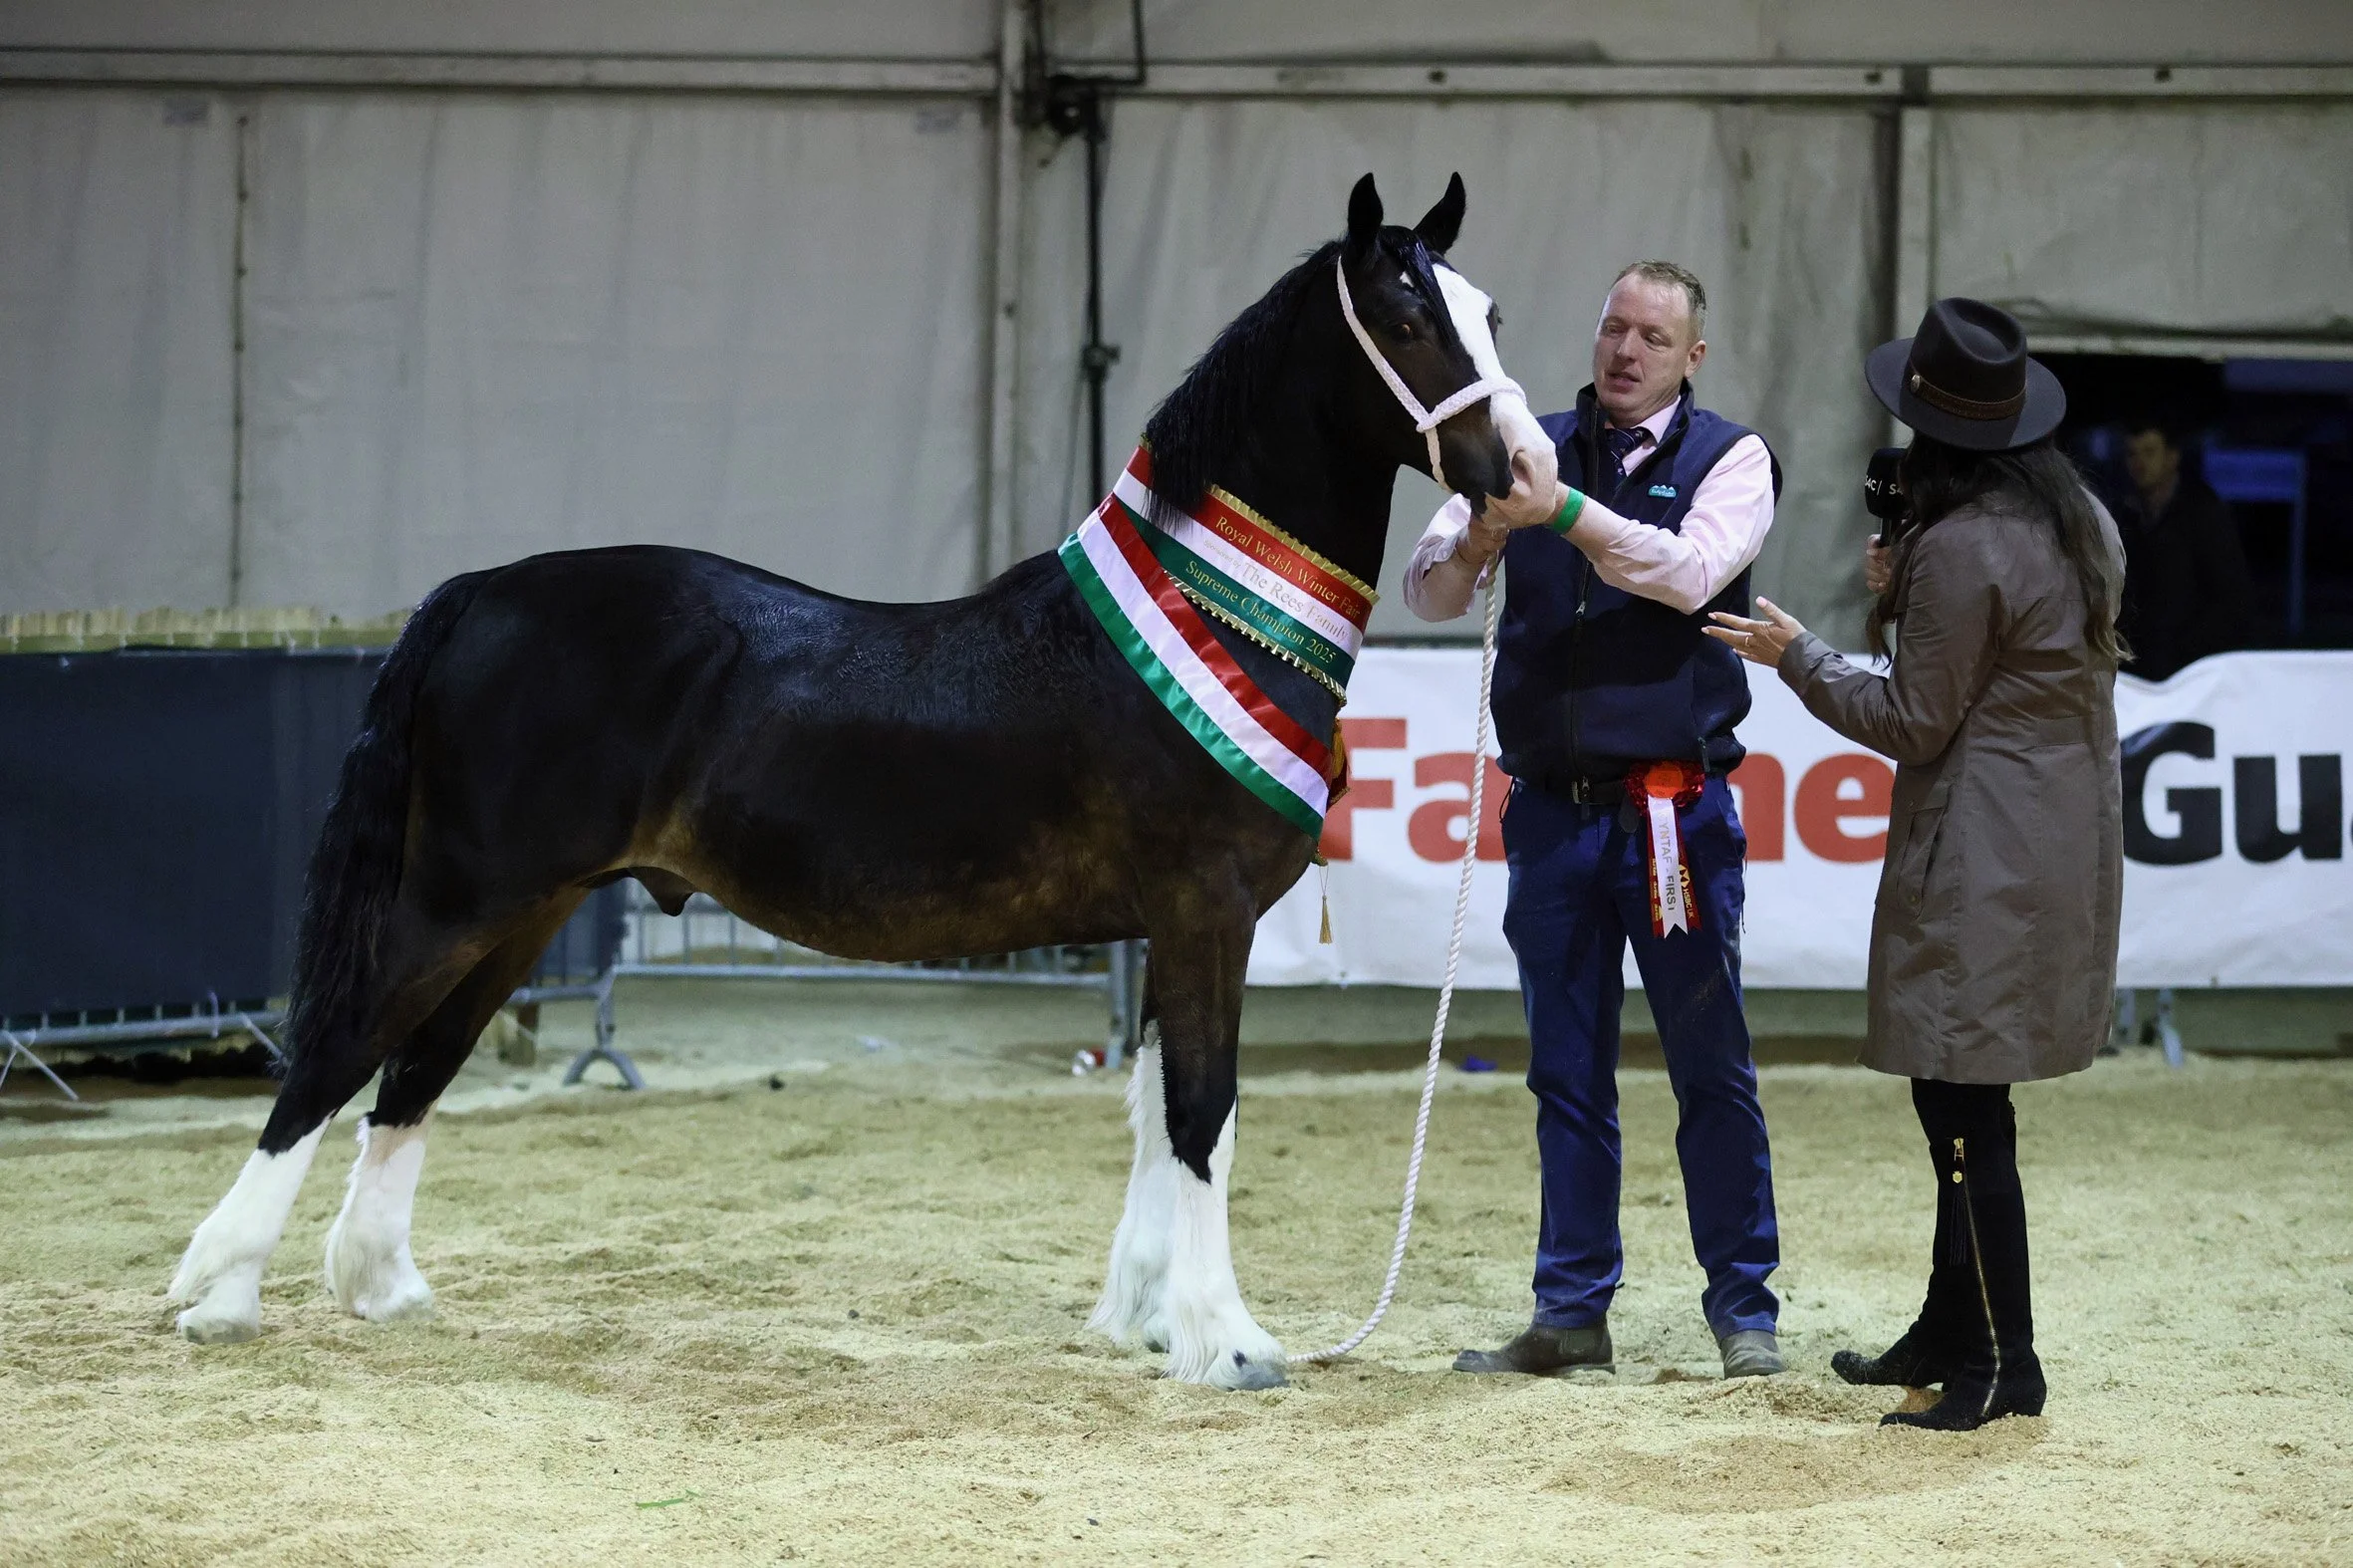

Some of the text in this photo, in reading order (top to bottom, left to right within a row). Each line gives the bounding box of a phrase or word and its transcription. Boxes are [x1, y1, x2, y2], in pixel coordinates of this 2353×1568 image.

[1185, 560, 1338, 664] Supreme Champion 2025
[1215, 516, 1361, 618] Royal Welsh Winter Fair
[1242, 562, 1268, 589] The
[1269, 581, 1304, 613] Rees
[1306, 605, 1349, 644] Family
[2120, 720, 2353, 866] Gu
[1683, 888, 1693, 908] HSBC
